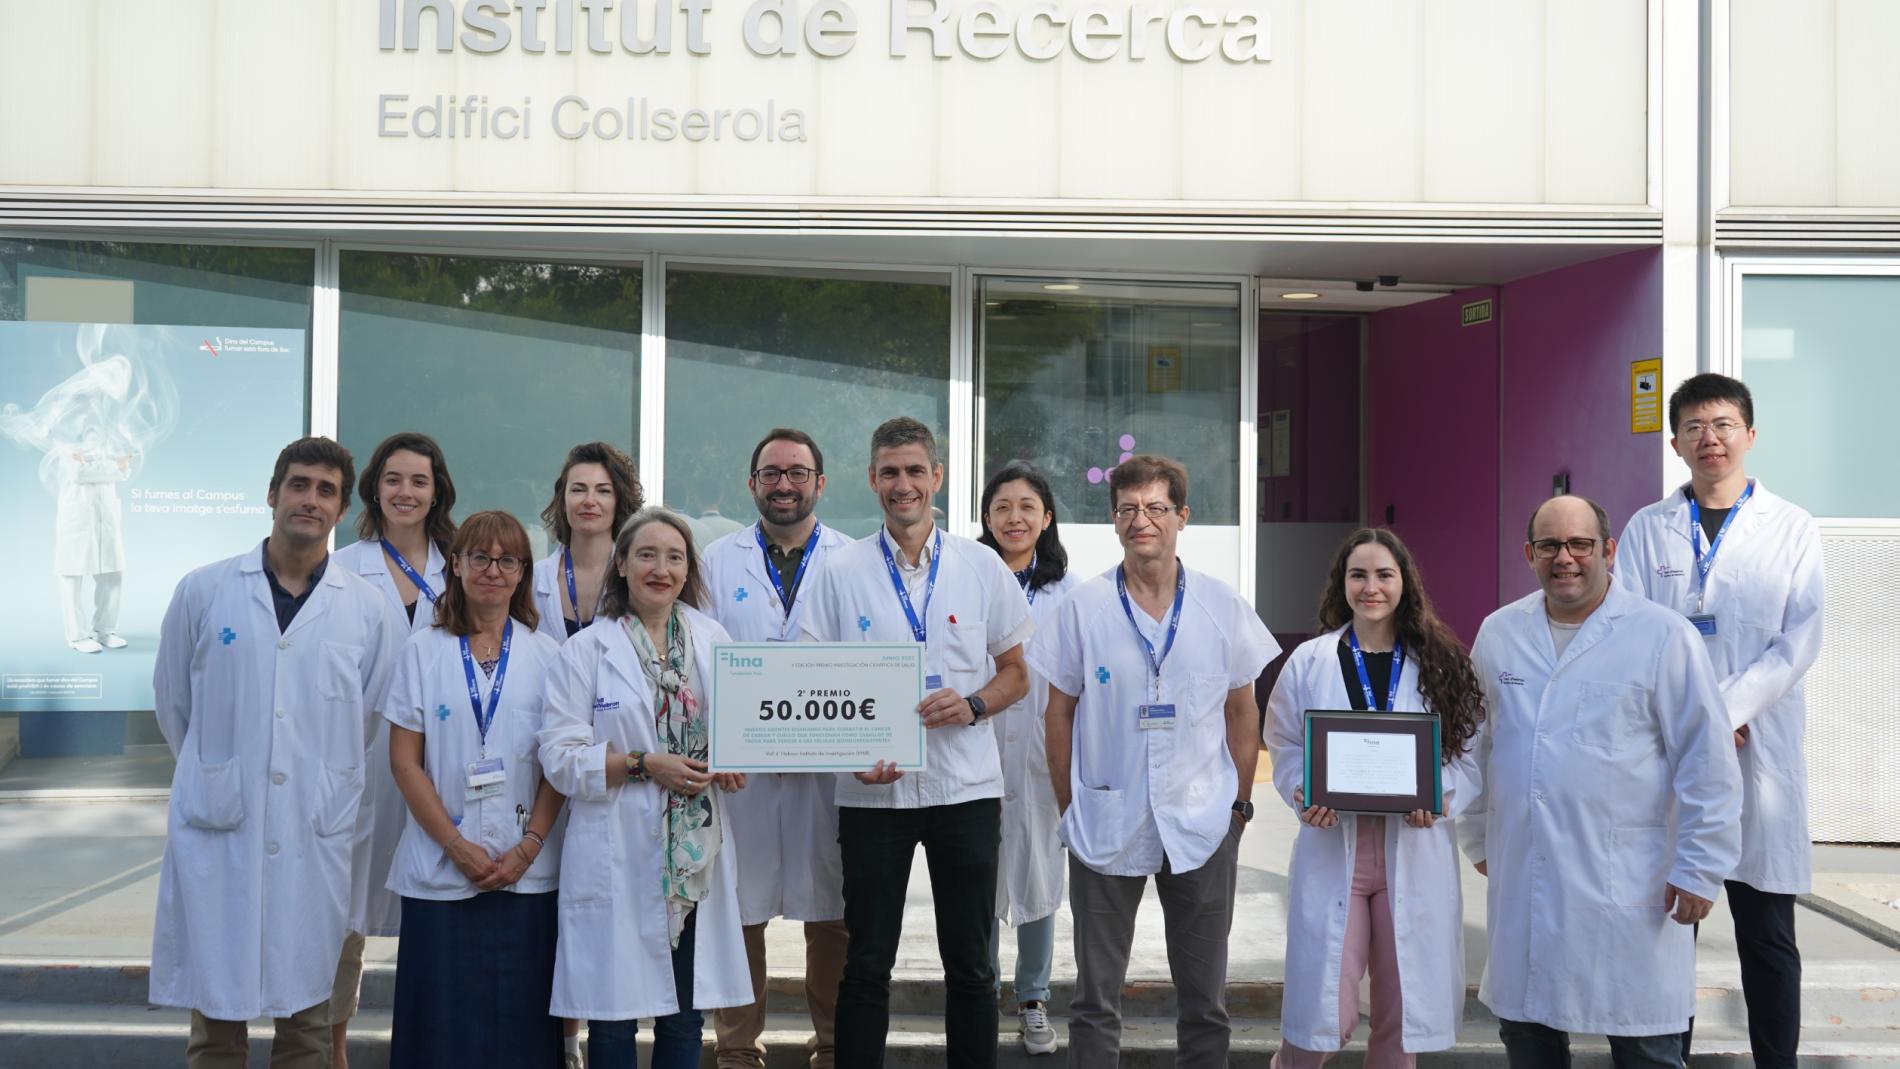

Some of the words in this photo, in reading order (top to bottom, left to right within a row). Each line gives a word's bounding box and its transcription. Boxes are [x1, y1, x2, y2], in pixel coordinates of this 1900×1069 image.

[379, 0, 712, 55] Institut
[742, 0, 858, 57] de
[888, 0, 1273, 64] Recerca
[378, 94, 532, 139] Edifici
[551, 95, 808, 142] Collserola
[131, 488, 142, 500] Si
[144, 488, 180, 500] fumes
[182, 489, 193, 500] al
[196, 489, 245, 503] Campus
[130, 503, 142, 513] la
[144, 503, 170, 514] teva
[173, 503, 215, 516] imatge
[730, 652, 763, 668] hna
[759, 698, 876, 721] 50.000€
